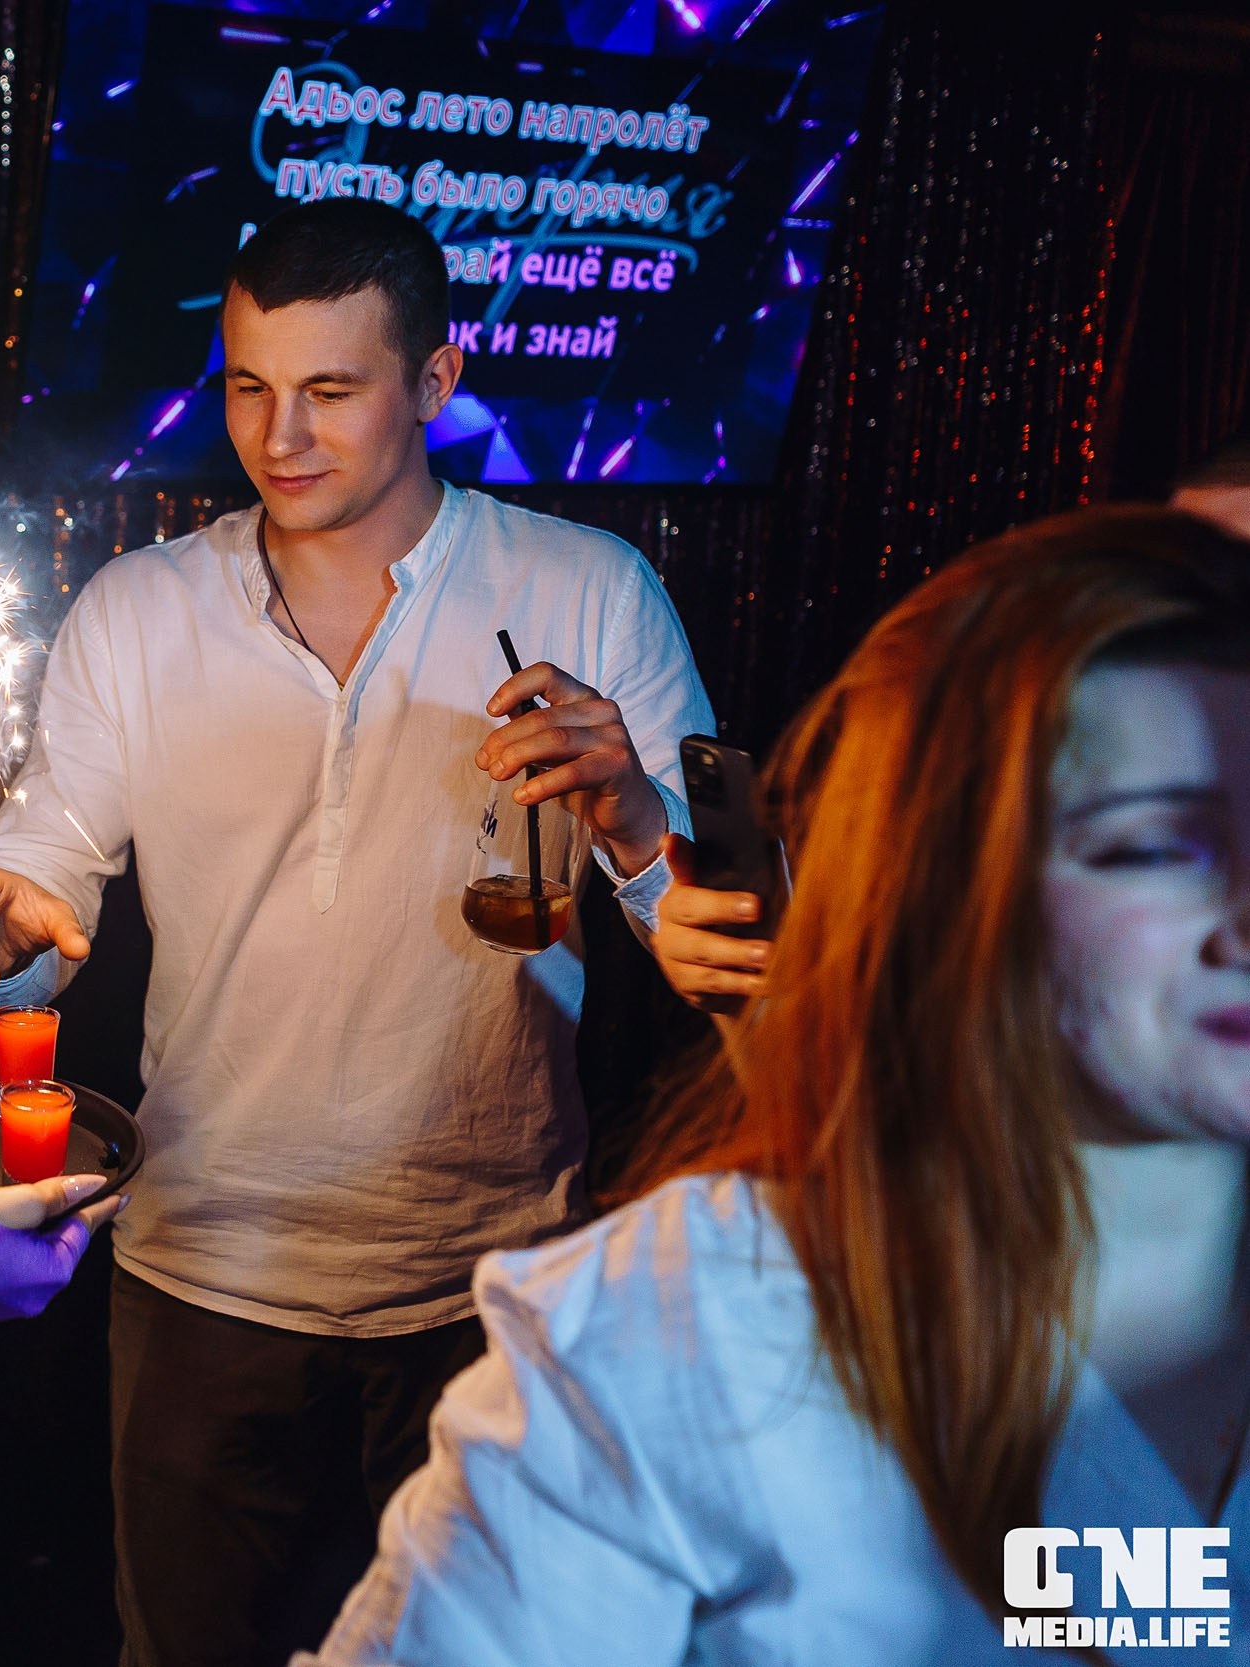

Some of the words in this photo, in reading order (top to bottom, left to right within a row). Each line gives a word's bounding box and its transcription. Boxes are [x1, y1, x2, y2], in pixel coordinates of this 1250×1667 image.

[260, 67, 405, 126] Адьос
[409, 91, 512, 136] лето
[518, 102, 709, 154] напролёт
[275, 158, 404, 204] пусть
[412, 160, 526, 212] было
[533, 177, 670, 227] горячо
[441, 237, 513, 285] рай
[521, 247, 603, 293] ещё
[609, 249, 678, 292] всё
[490, 322, 519, 354] и
[524, 315, 619, 358] знай
